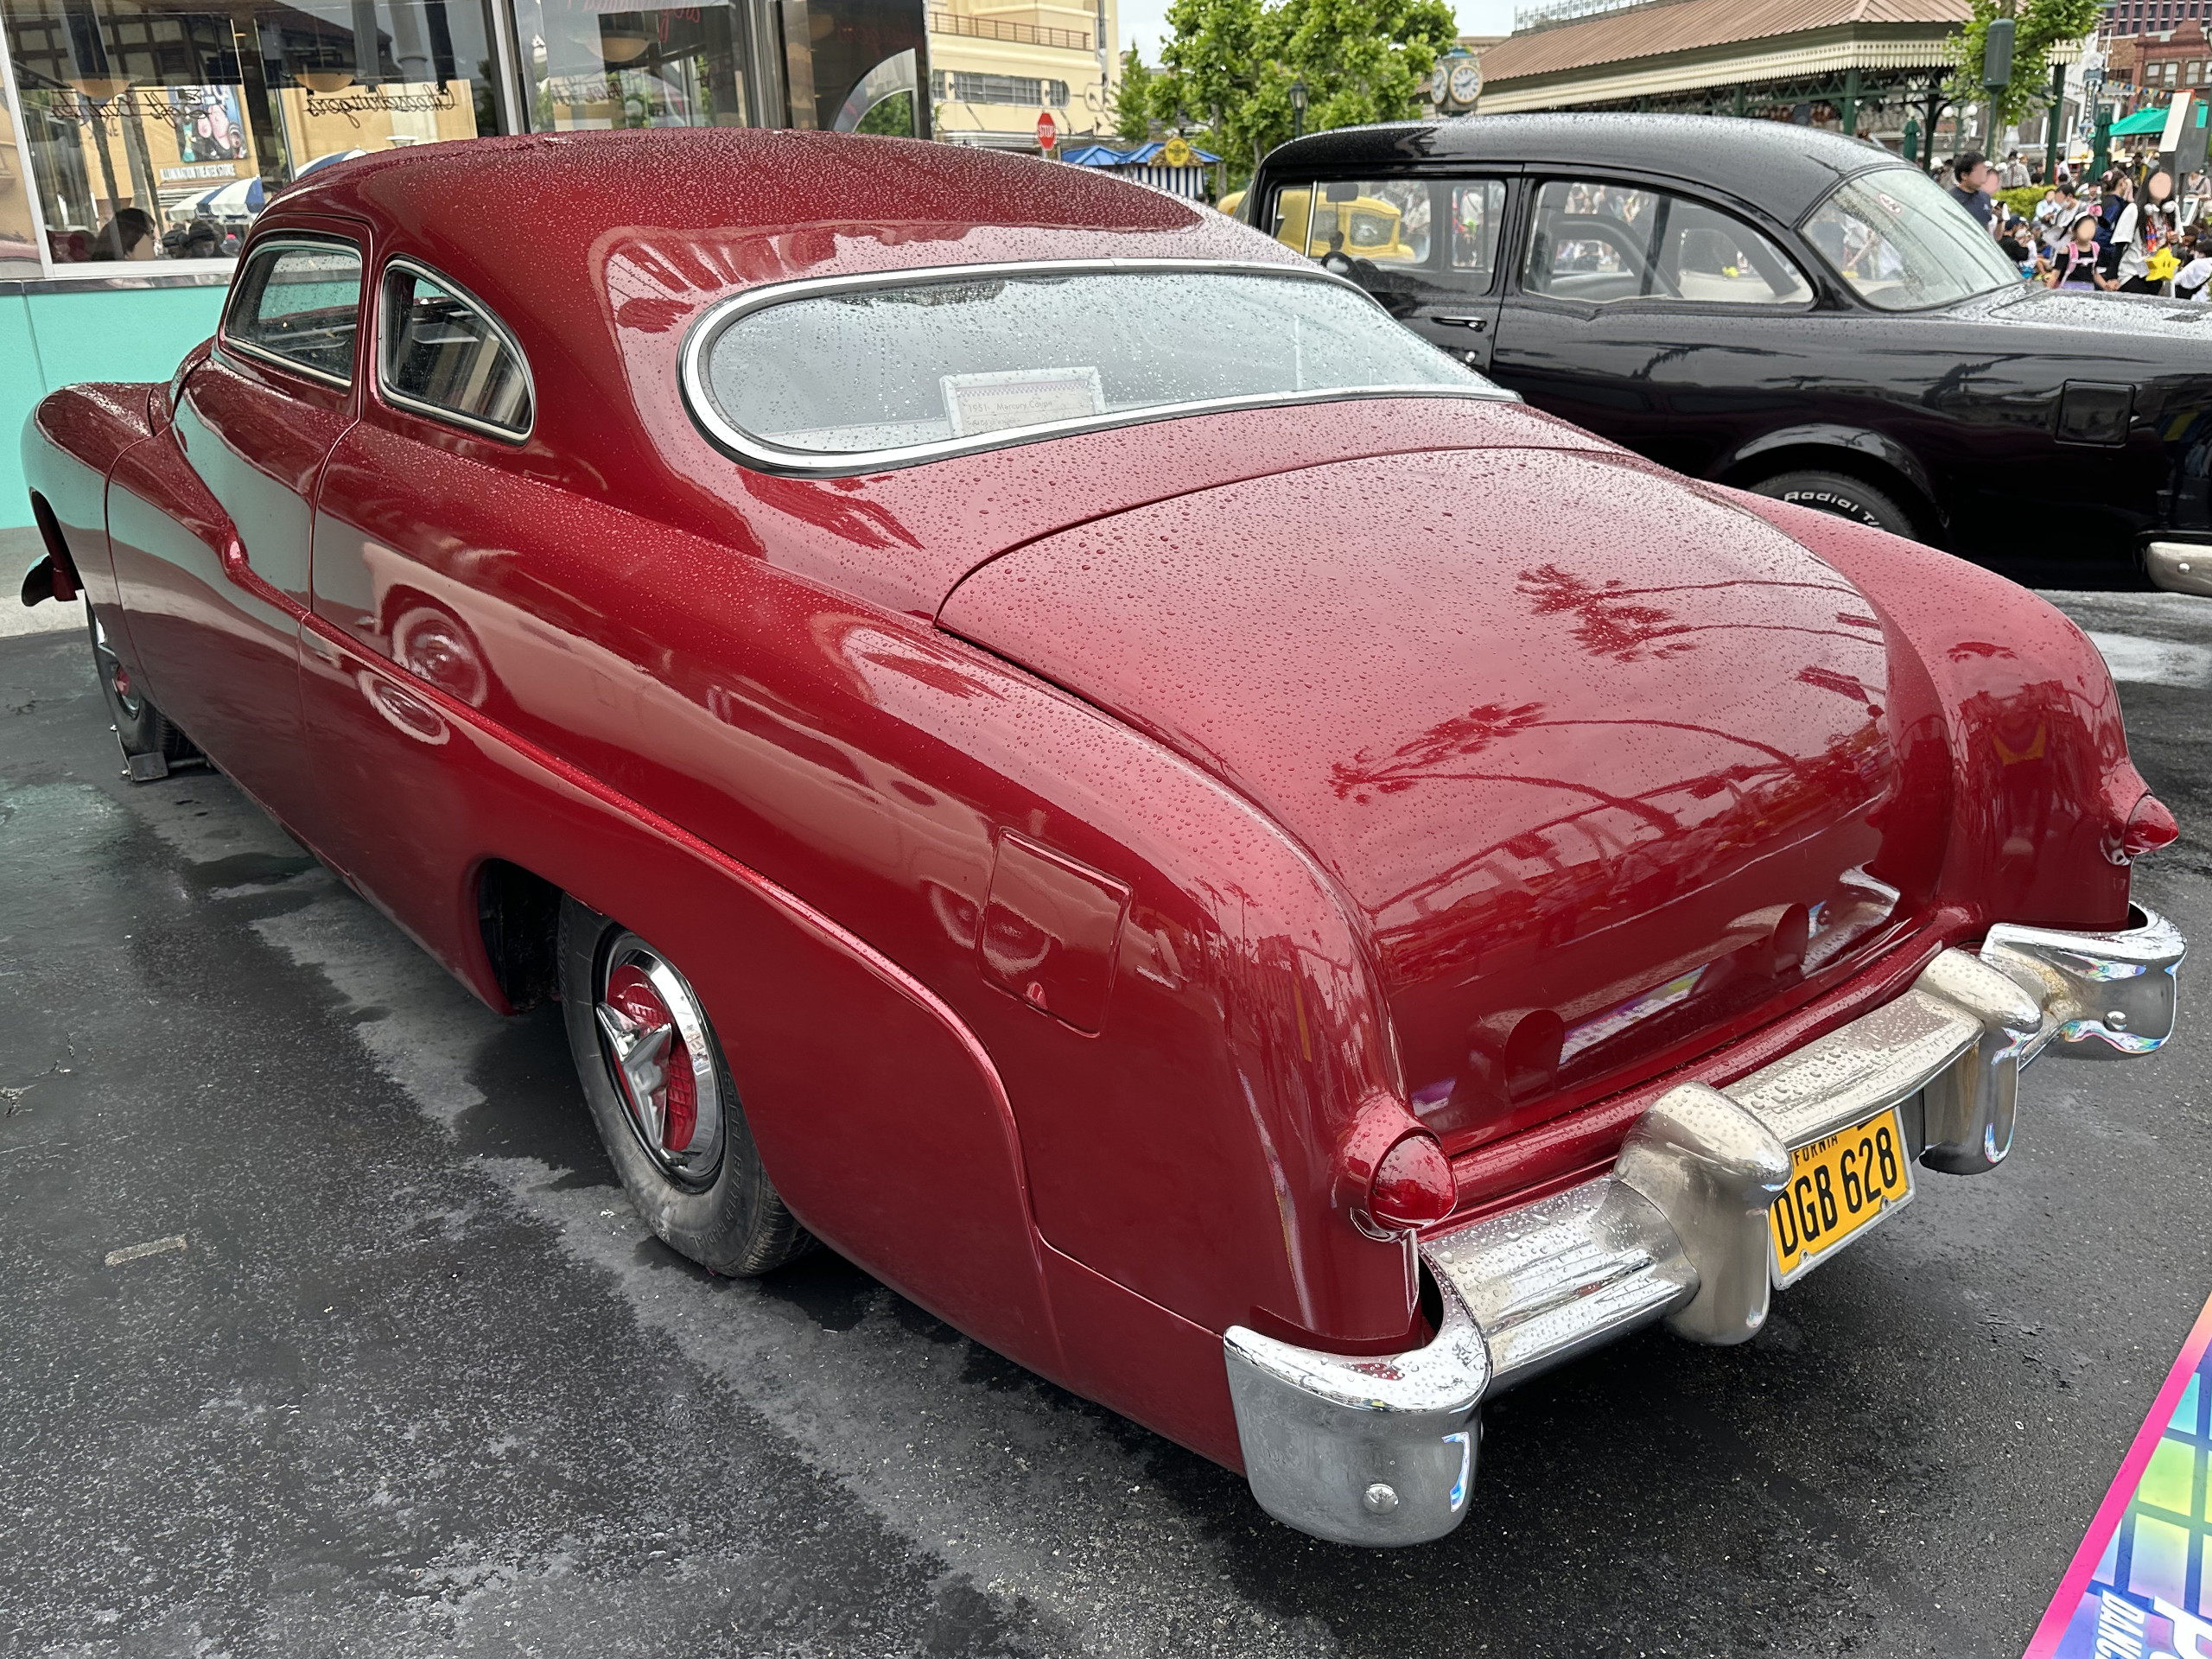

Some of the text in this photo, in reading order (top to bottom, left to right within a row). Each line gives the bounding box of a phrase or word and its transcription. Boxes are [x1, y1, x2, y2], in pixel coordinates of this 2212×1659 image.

[1038, 124, 1056, 138] STOP
[968, 404, 988, 413] 1951
[996, 401, 1027, 412] Mercury
[1784, 491, 1859, 512] Radial
[722, 1071, 741, 1142] STEEL
[1793, 1135, 1839, 1166] FORNIA
[1773, 1126, 1897, 1258] DGB 628
[2094, 1589, 2145, 1659] DANC
